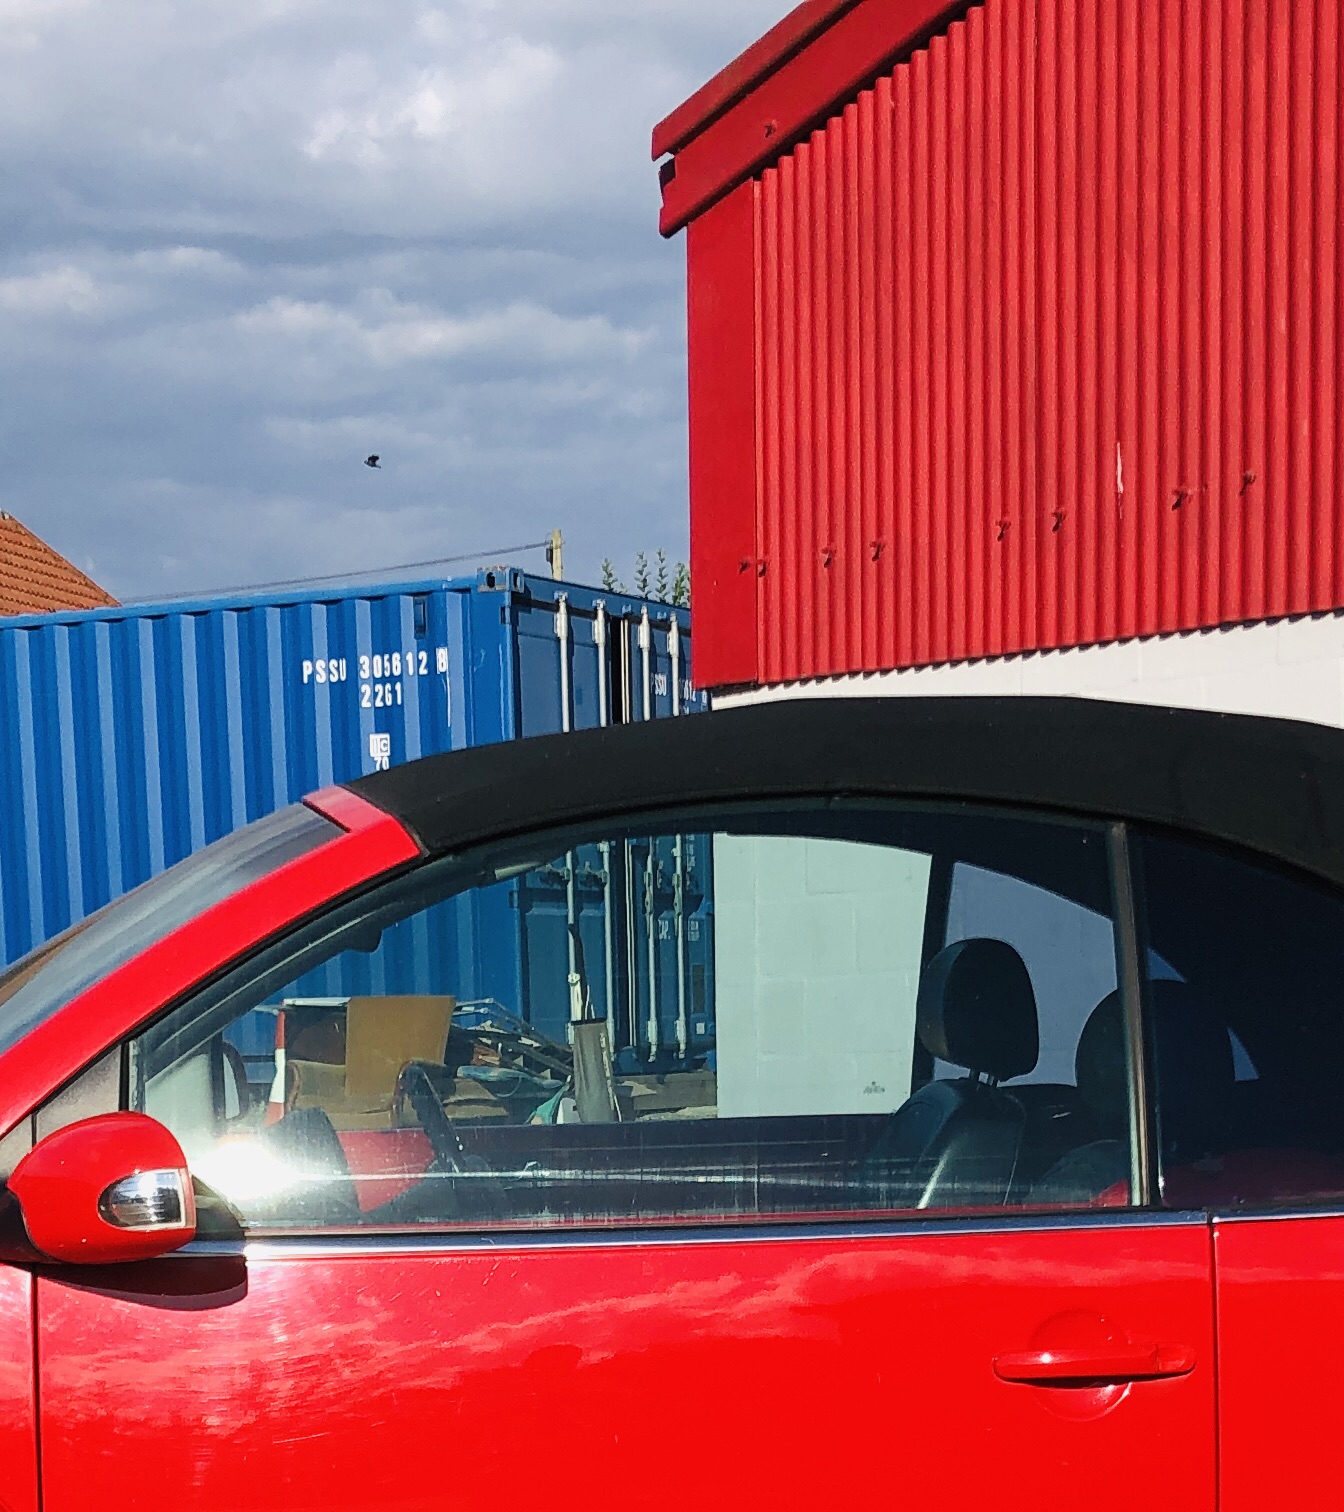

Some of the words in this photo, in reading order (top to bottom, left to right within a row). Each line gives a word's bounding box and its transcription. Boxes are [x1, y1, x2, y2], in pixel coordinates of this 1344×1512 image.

[302, 658, 347, 684] PSSU
[359, 652, 428, 680] 305612
[360, 682, 402, 708] 2261
